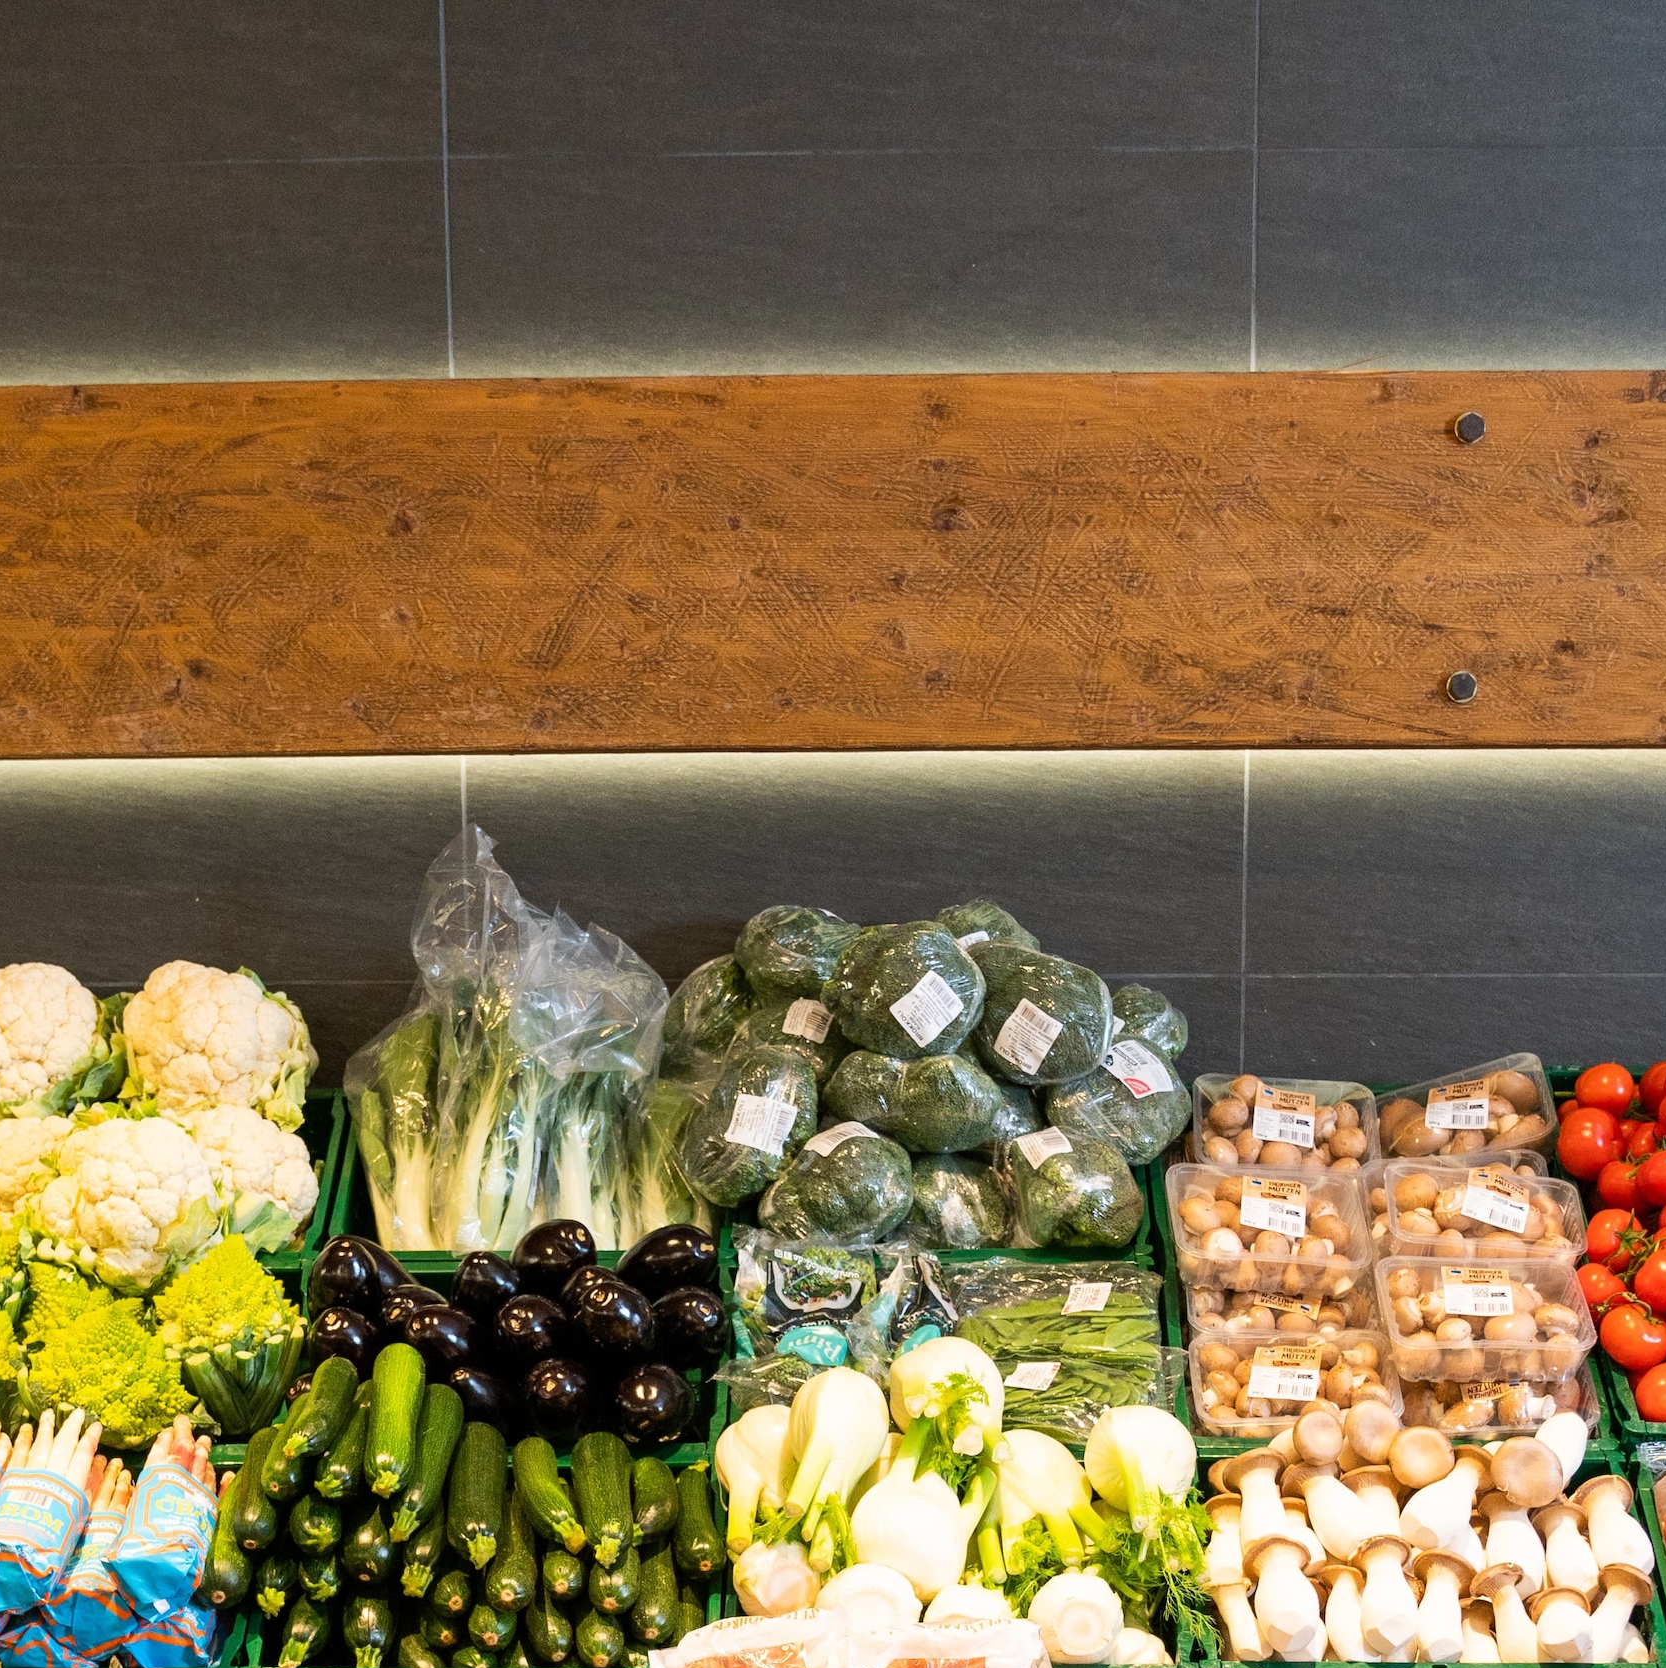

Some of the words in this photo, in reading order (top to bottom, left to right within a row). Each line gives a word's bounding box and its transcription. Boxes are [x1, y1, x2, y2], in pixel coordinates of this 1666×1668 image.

[1279, 1097, 1310, 1106] MÜTZEN
[1268, 1186, 1301, 1195] MÜTZEN
[1282, 1352, 1316, 1361] MÜTZEN
